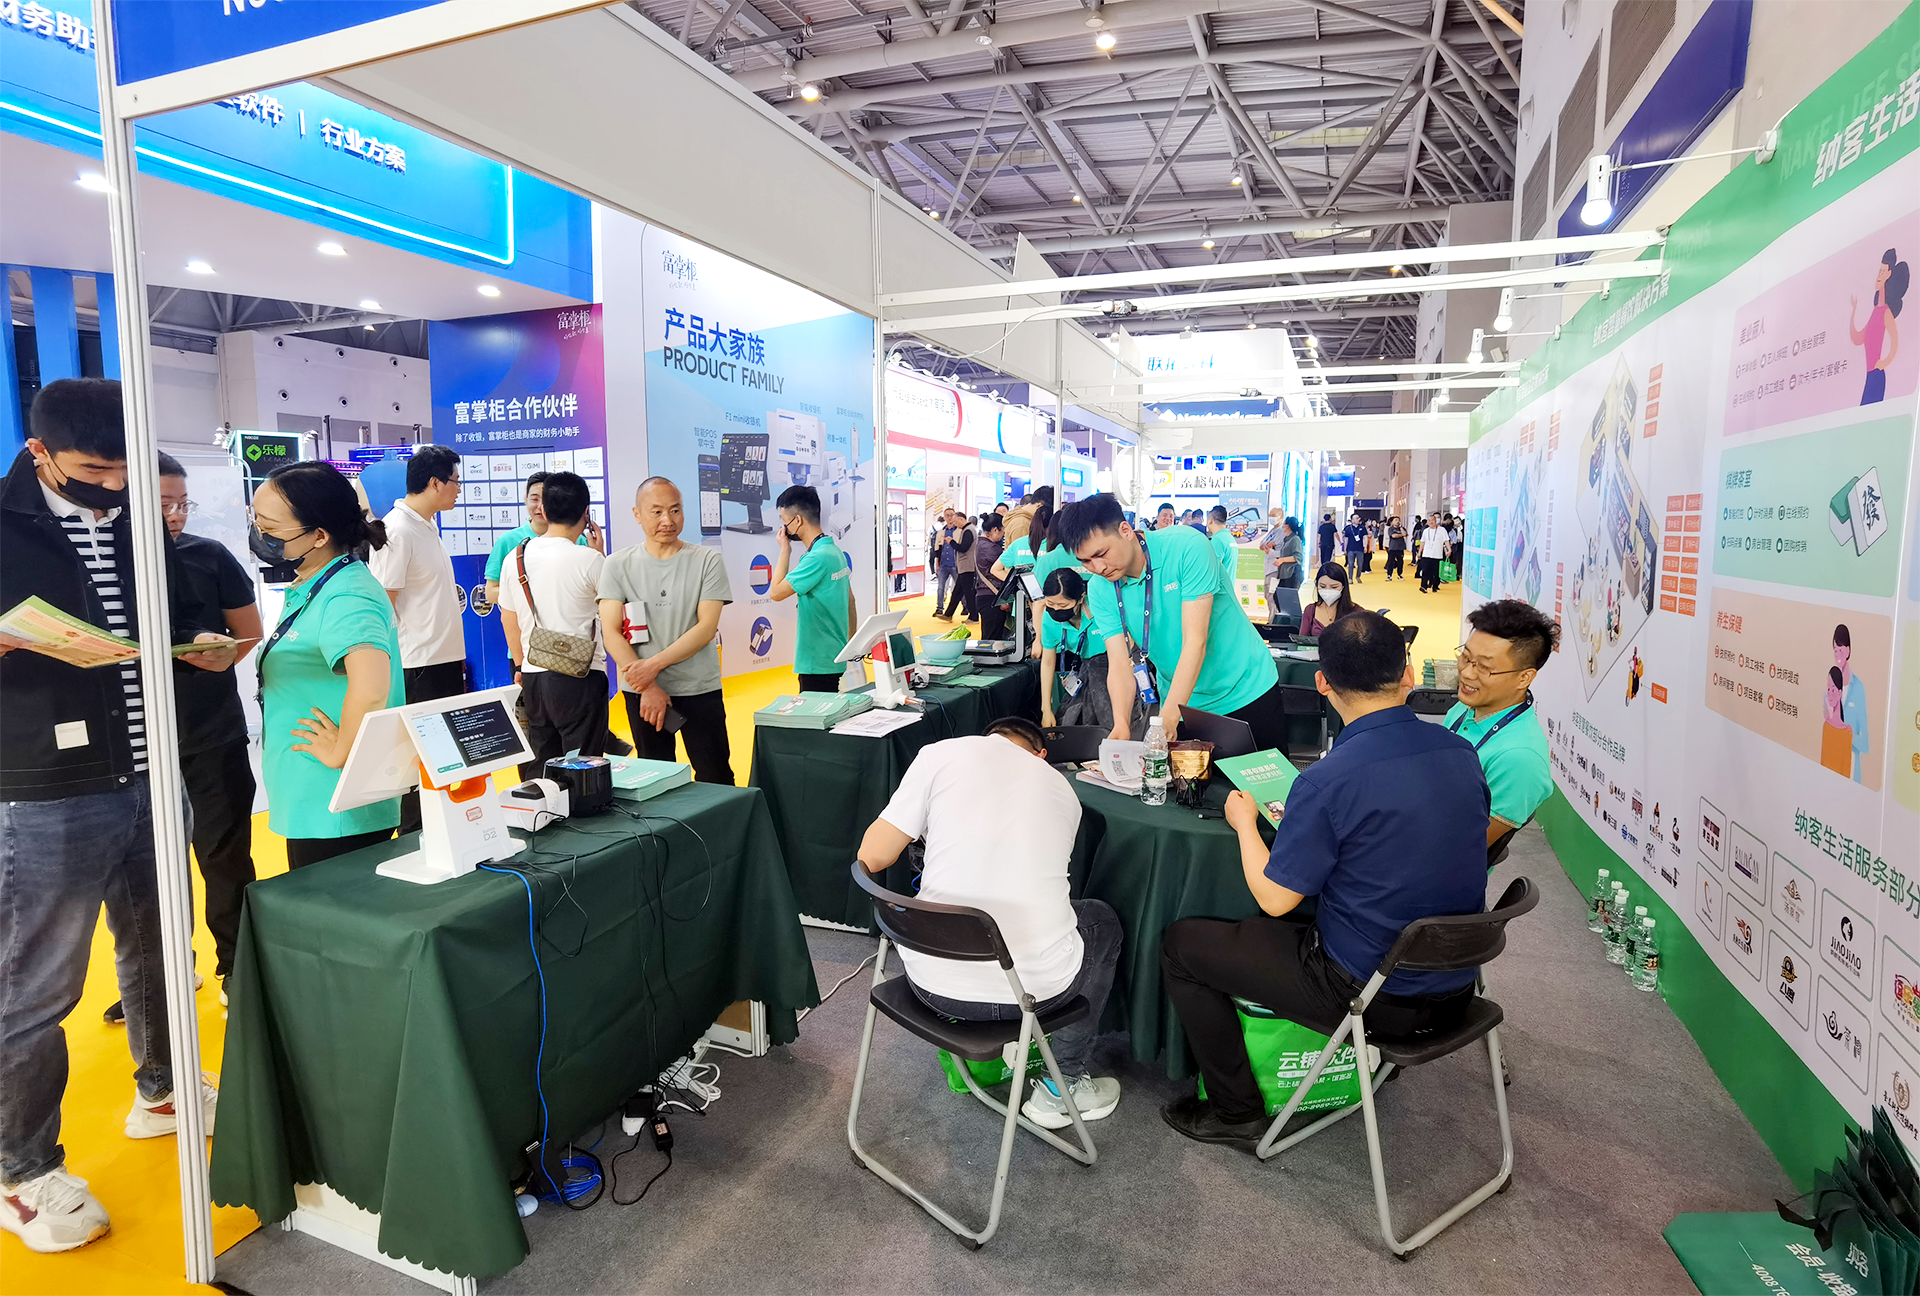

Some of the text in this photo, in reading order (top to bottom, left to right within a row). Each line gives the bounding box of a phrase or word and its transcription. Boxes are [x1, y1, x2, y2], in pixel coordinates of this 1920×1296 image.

[319, 118, 406, 173] 行业方案
[662, 249, 698, 282] 富掌柜
[557, 310, 592, 331] 富掌柜
[664, 307, 766, 367] 产品大家族
[663, 345, 785, 395] PRODUCT FAMILY
[454, 393, 578, 425] 富掌柜合作伙伴
[1752, 1262, 1779, 1288] 4008
